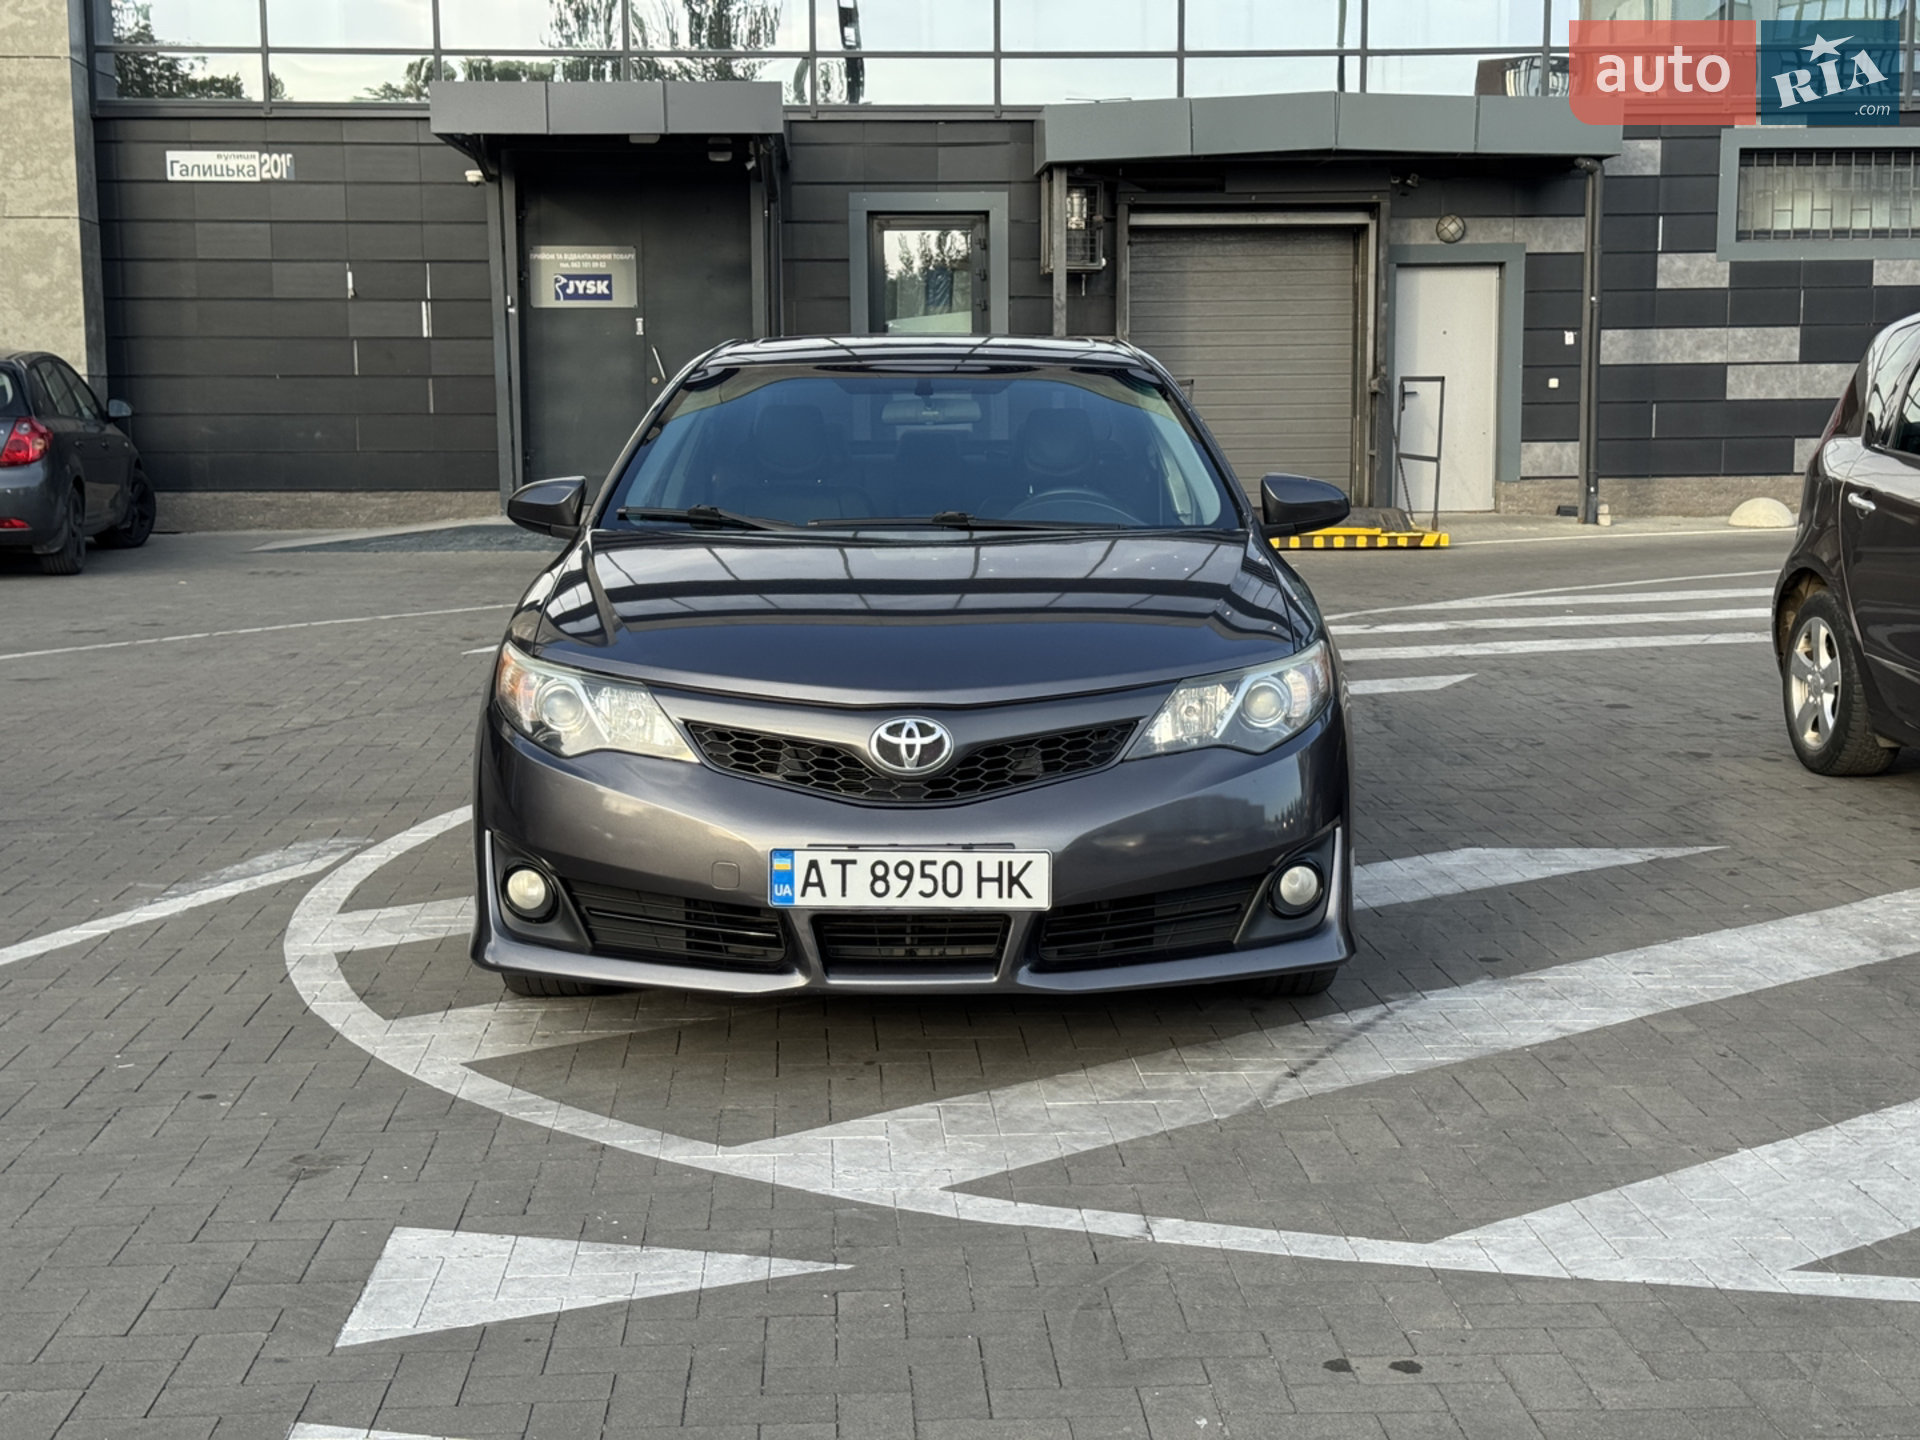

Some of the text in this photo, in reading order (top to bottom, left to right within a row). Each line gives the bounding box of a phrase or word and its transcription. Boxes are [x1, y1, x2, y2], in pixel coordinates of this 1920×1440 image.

[216, 153, 257, 161] вулиця
[170, 160, 257, 178] Галицька
[565, 279, 610, 294] JYSK
[774, 859, 1033, 899] UA AT 8950 HK
